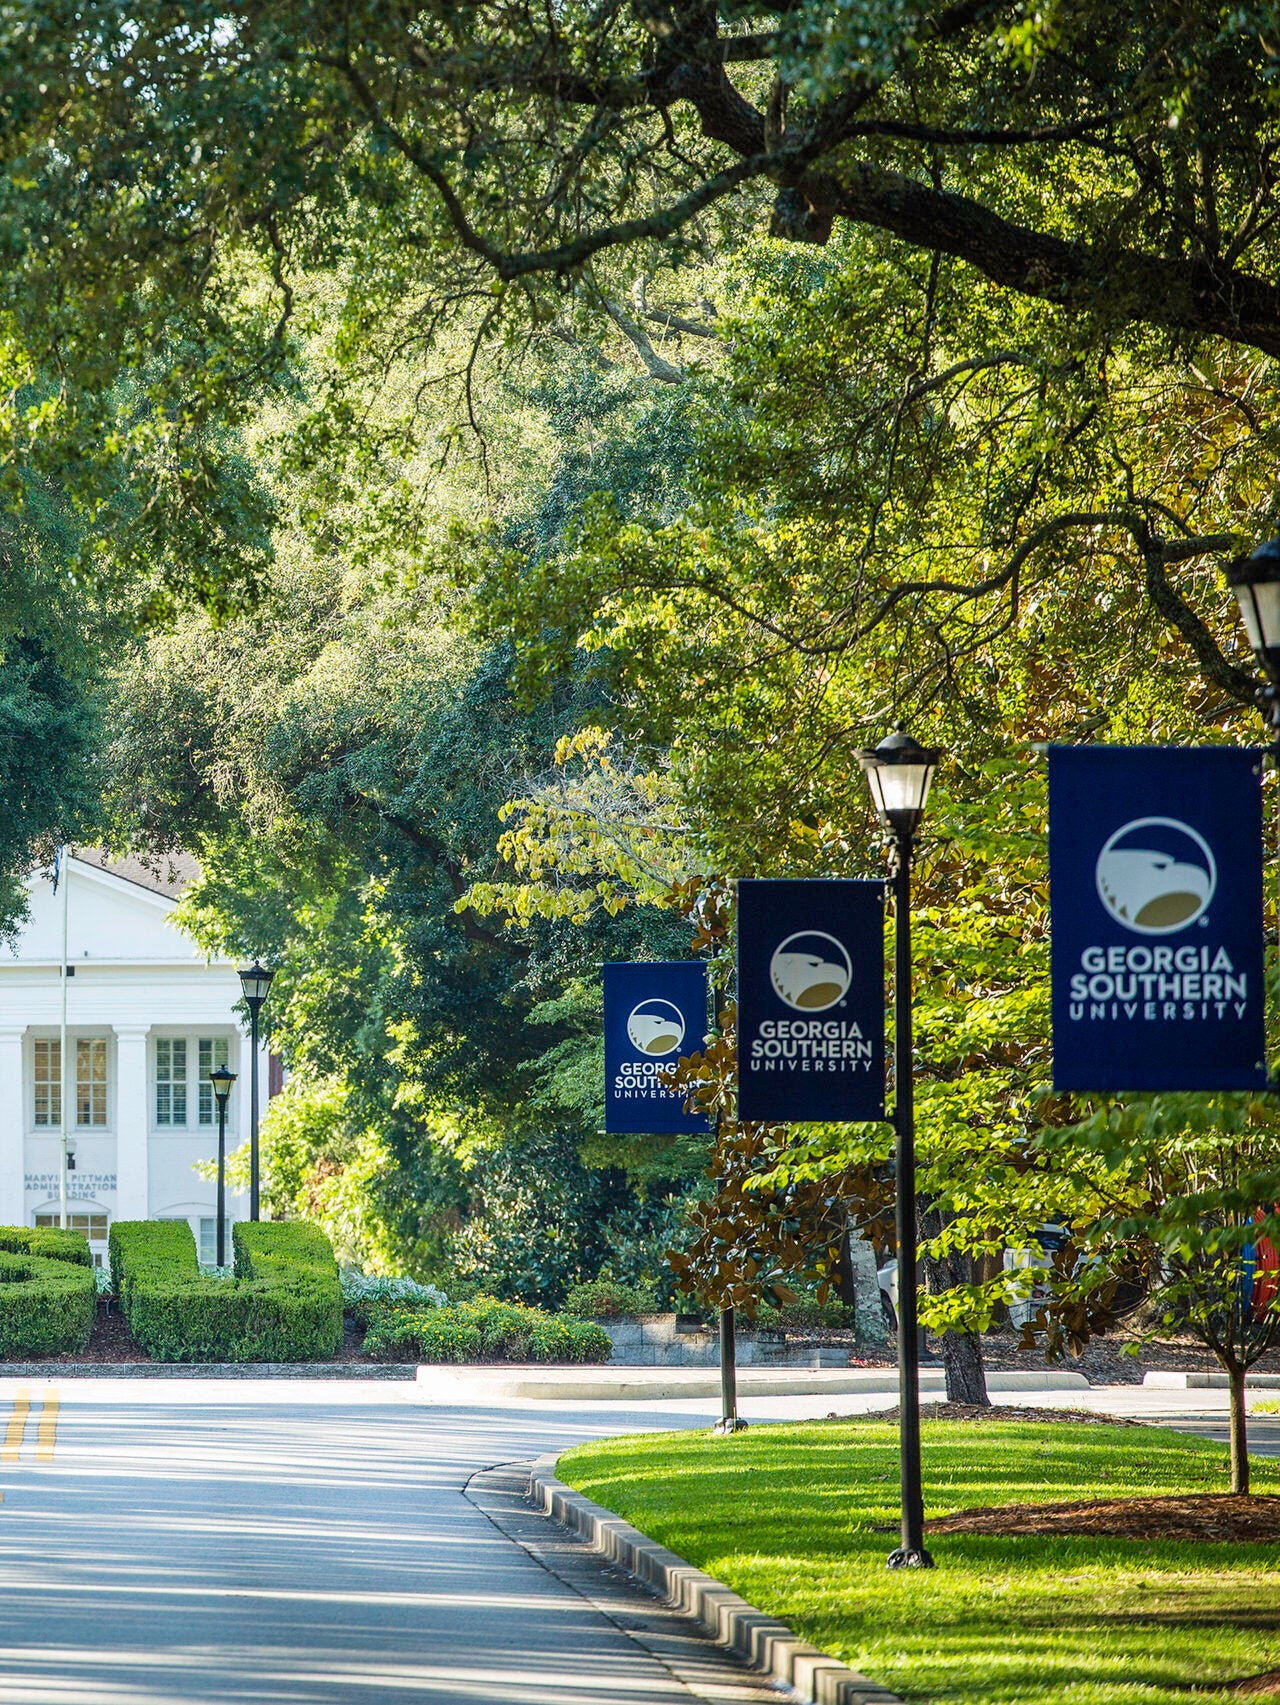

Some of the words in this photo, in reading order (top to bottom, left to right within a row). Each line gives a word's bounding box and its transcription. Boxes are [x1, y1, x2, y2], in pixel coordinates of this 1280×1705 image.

[1080, 945, 1234, 973] GEORGIA
[1070, 972, 1248, 1001] SOUTHERN
[1069, 1001, 1248, 1021] UNIVERSITY
[759, 1020, 863, 1039] GEORGIA
[751, 1039, 873, 1058] SOUTHERN
[620, 1062, 680, 1076] GEORG
[750, 1059, 873, 1072] UNIVERSITY
[614, 1090, 690, 1098] UNIVERSI
[24, 1174, 61, 1182] MARVI
[71, 1174, 117, 1182] PITTMAN
[24, 1183, 117, 1191] ADMINSTRATION
[47, 1191, 96, 1199] BULDING
